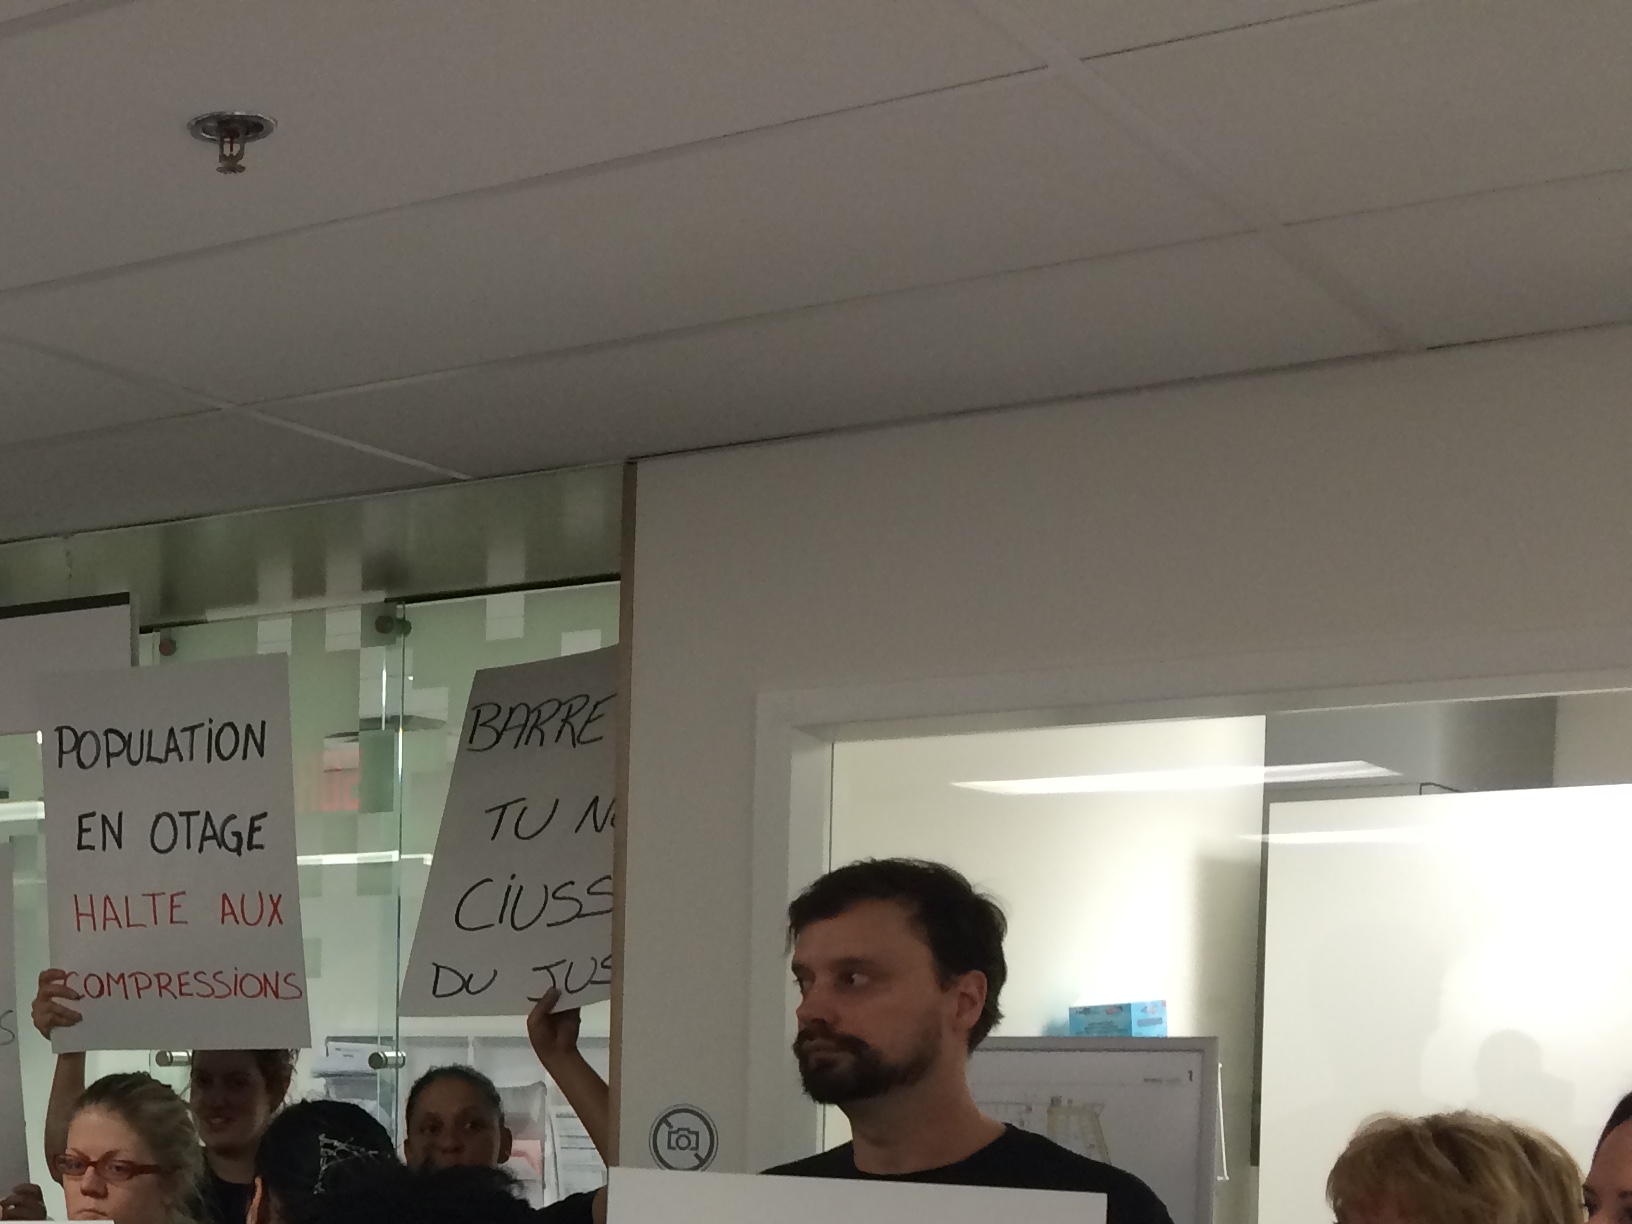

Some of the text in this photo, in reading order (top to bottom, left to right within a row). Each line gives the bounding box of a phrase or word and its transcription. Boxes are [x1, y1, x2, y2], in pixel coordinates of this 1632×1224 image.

[55, 718, 266, 769] POPULATION
[467, 693, 618, 752] BARRE
[76, 811, 268, 856] EN OTAGE
[485, 796, 616, 841] TU N
[74, 891, 284, 931] HALTE AUX
[454, 873, 613, 931] CIUSS
[64, 967, 304, 1000] COMPRESSIONS
[431, 962, 497, 999] DU
